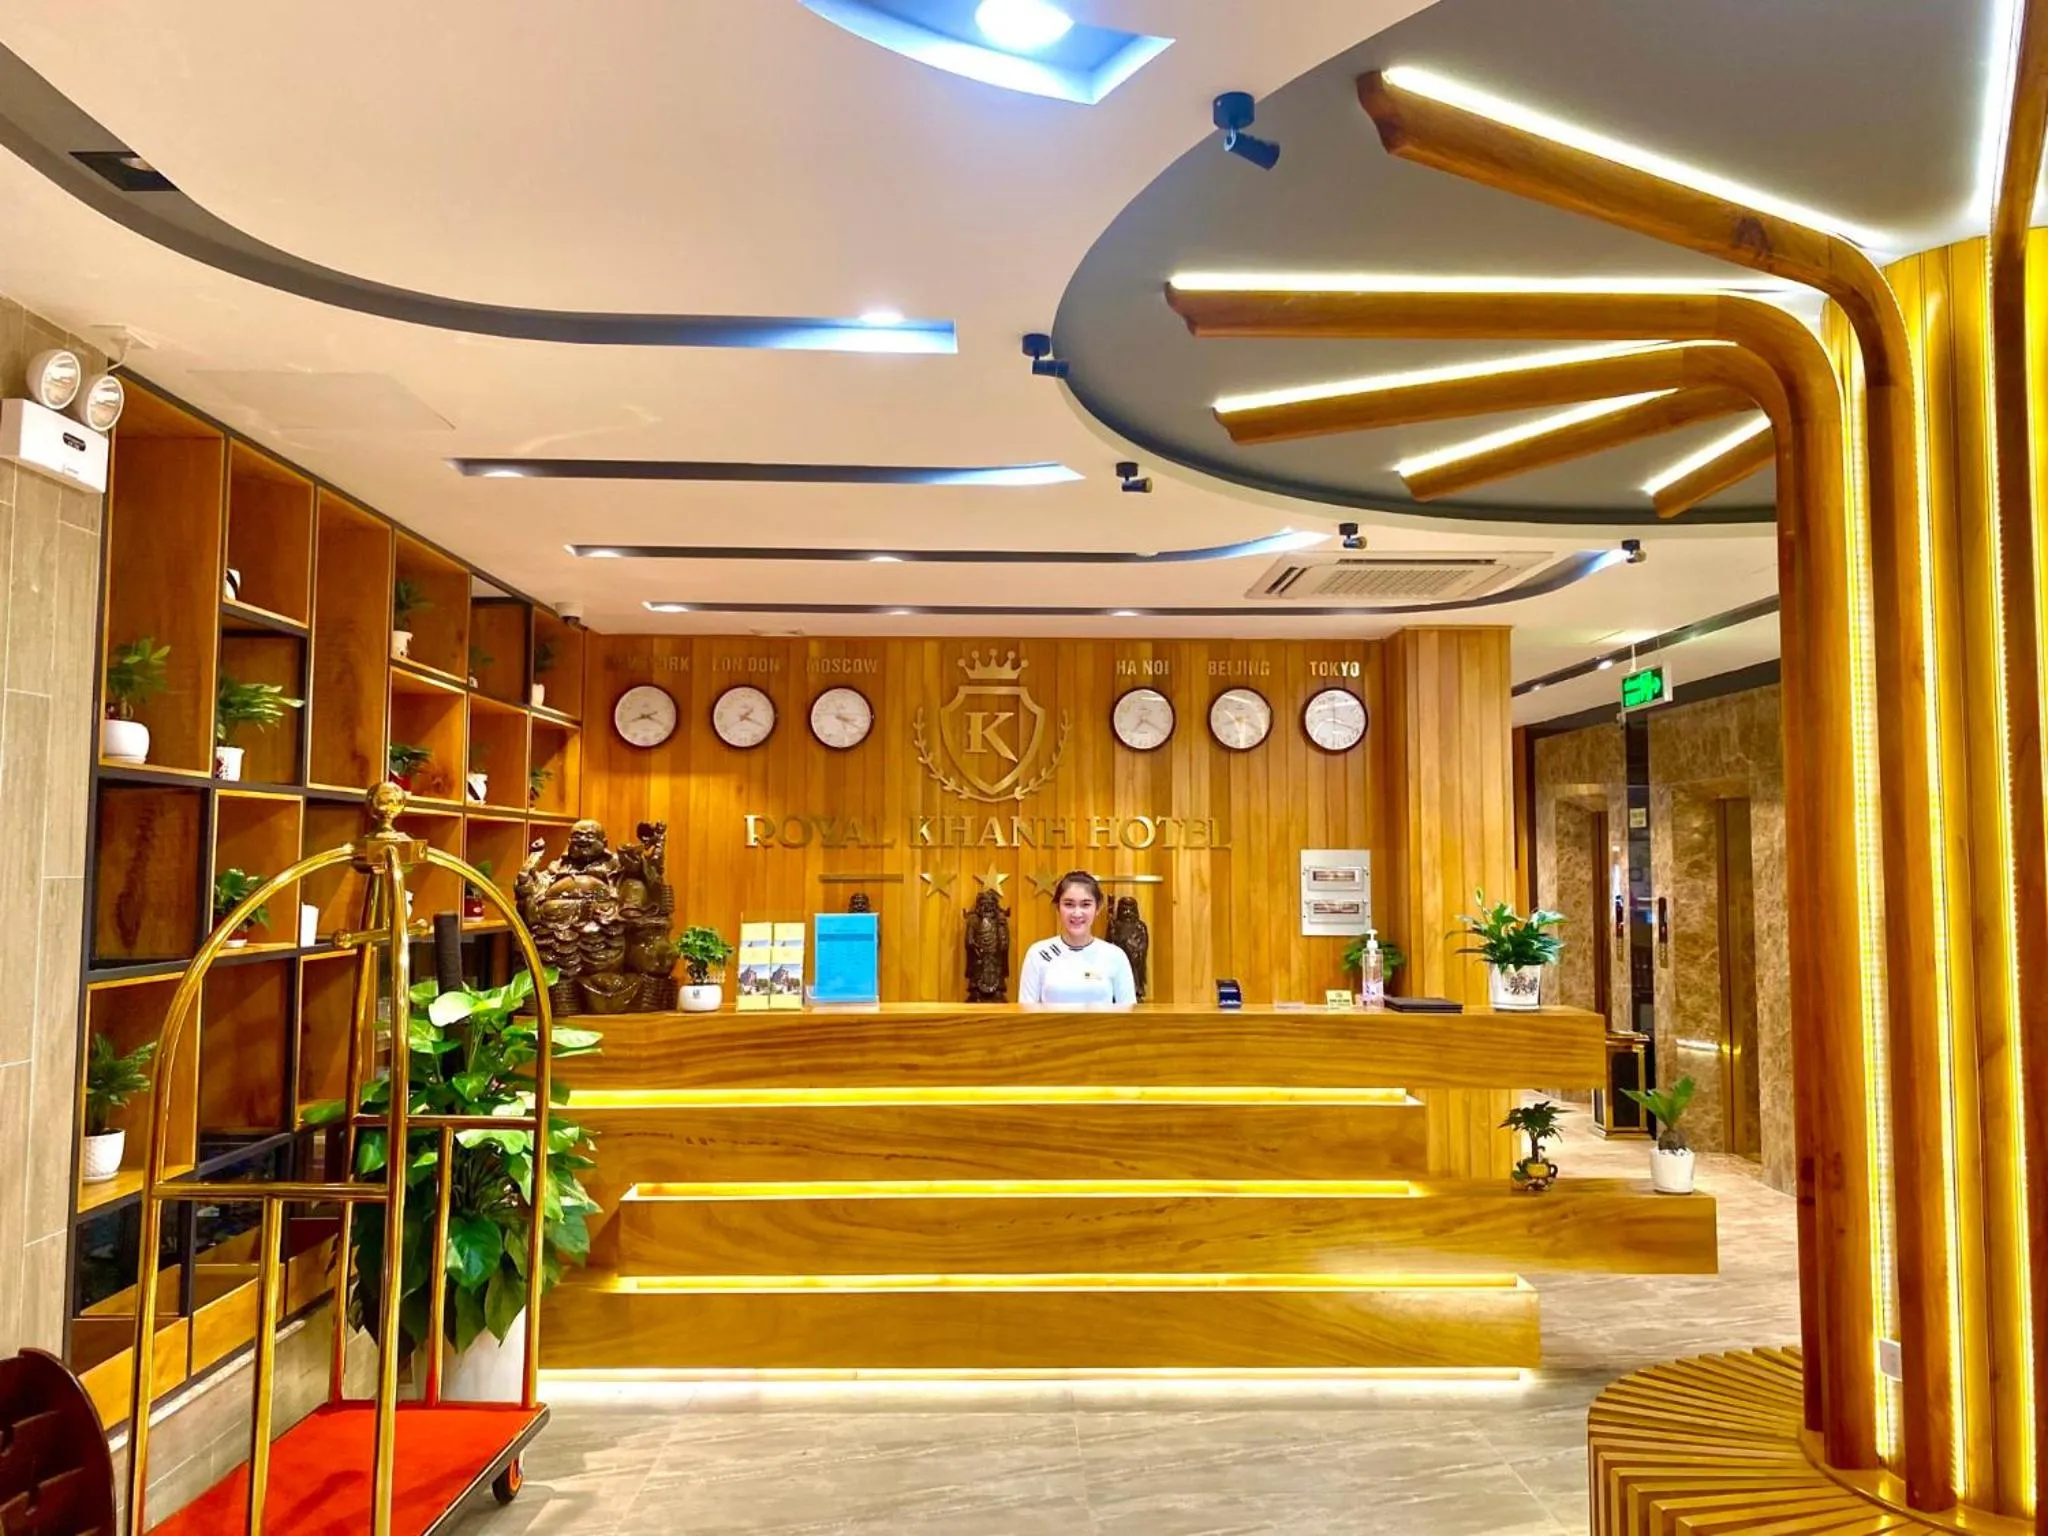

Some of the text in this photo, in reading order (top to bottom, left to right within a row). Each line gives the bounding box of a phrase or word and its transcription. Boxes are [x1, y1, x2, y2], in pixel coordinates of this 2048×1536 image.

[806, 657, 879, 674] MOSCOW
[1116, 660, 1170, 676] HA NOI
[1208, 660, 1271, 676] BEIJING
[1309, 661, 1361, 678] TOKYO
[964, 710, 1018, 763] K
[743, 814, 1232, 849] ROYAL KHANH HOTEL
